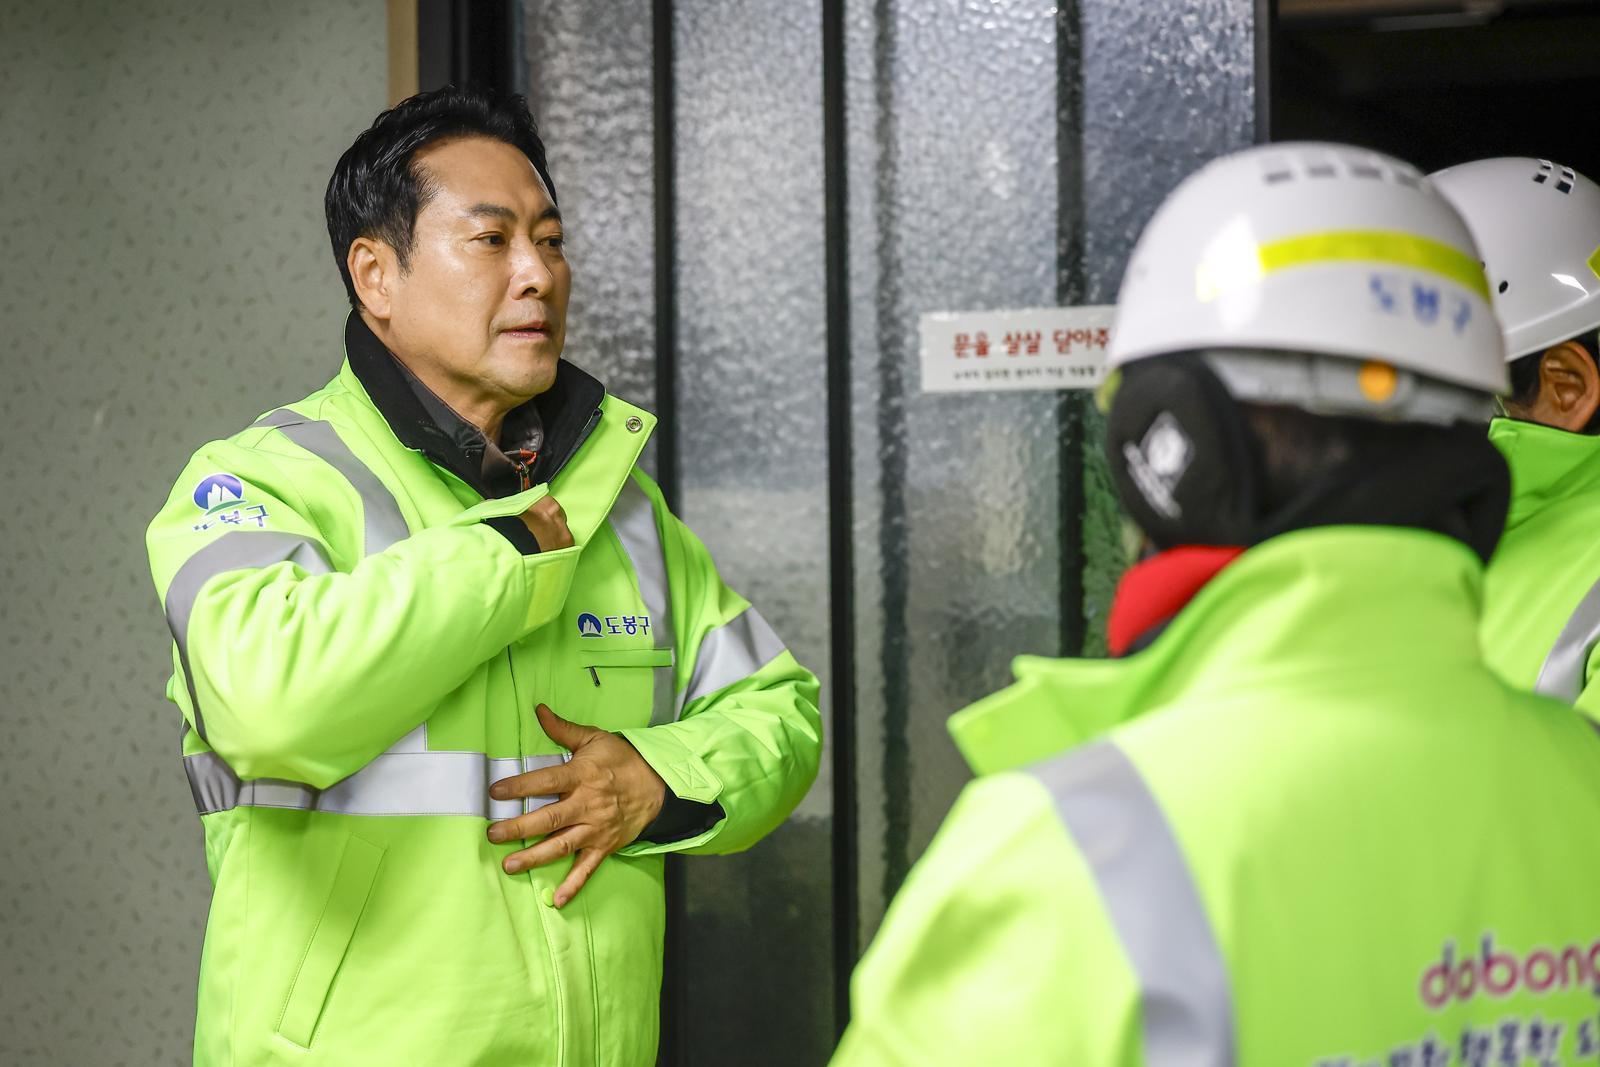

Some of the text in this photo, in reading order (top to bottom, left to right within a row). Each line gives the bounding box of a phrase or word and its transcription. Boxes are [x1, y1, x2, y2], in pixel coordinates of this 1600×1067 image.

[954, 331, 989, 358] 문을
[1003, 330, 1041, 356] 살살
[604, 615, 650, 636] 도봉구
